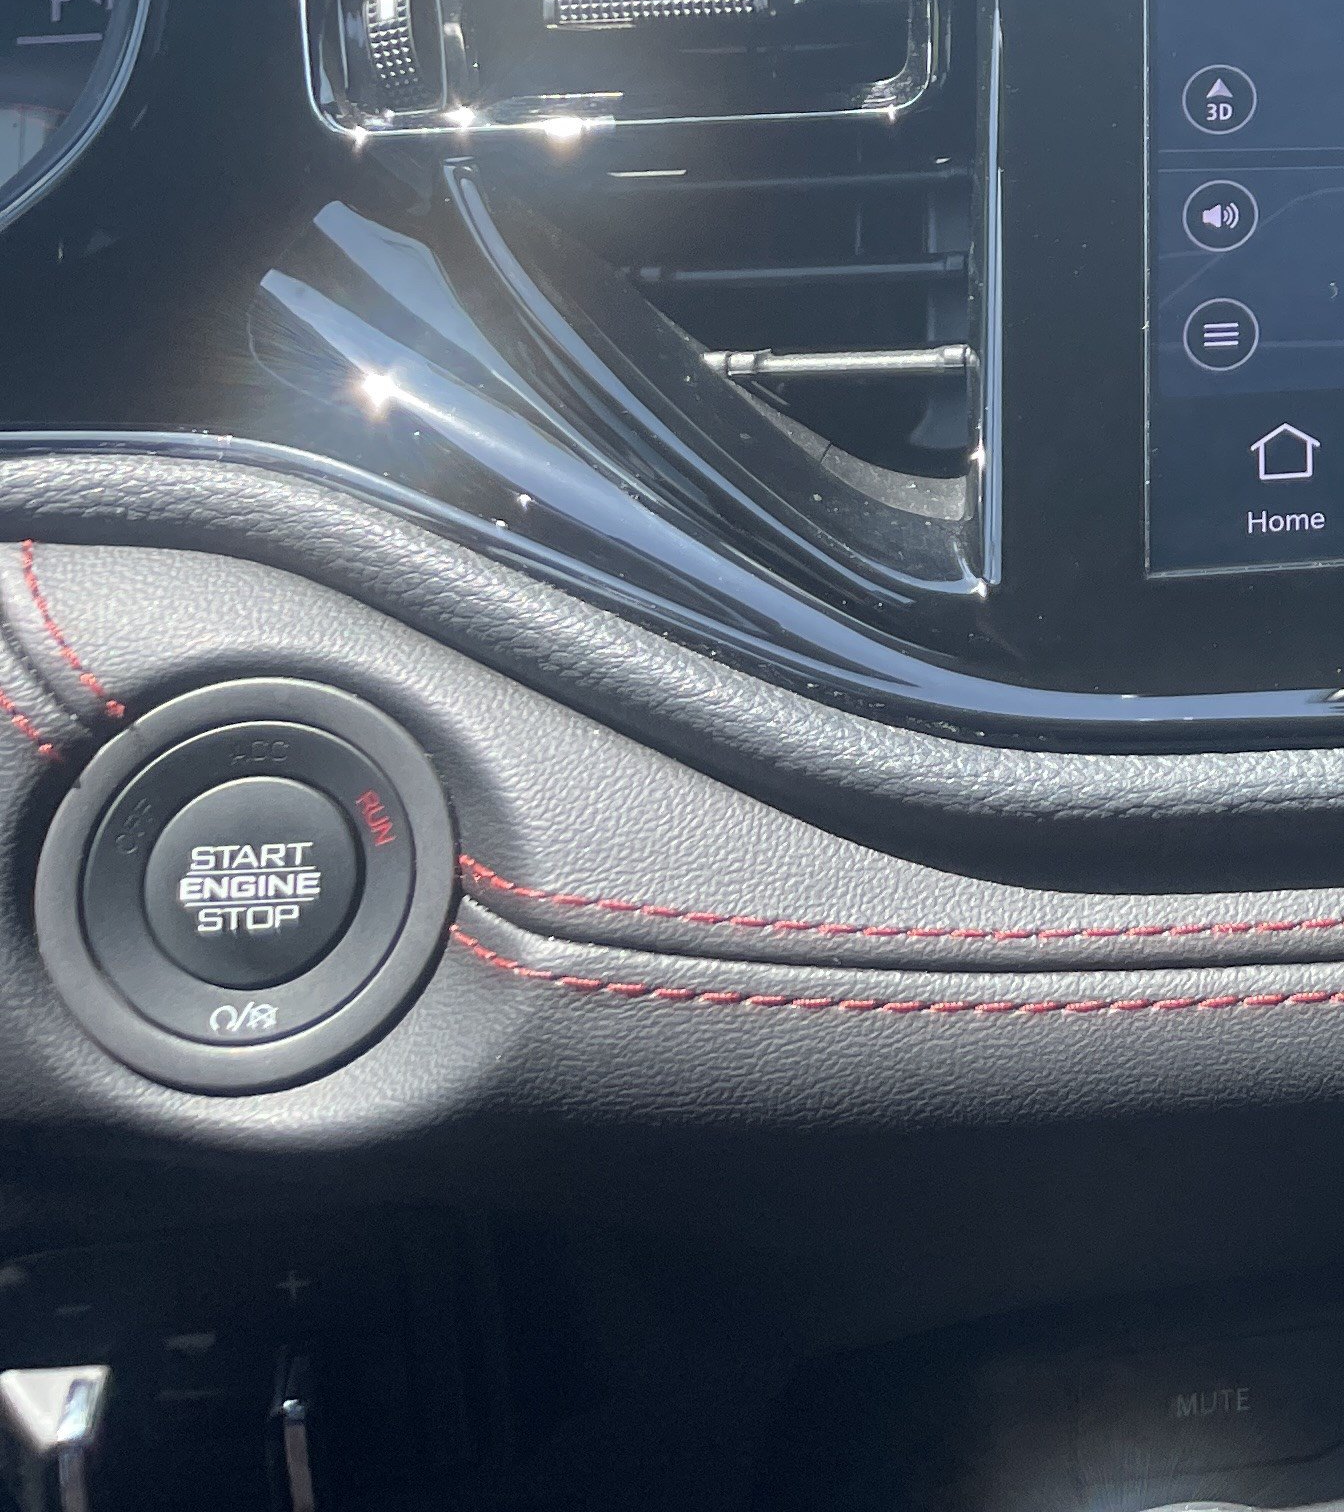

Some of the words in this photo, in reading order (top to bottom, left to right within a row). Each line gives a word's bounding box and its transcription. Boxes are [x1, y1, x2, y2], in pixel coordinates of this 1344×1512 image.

[1206, 103, 1233, 121] 3D
[1247, 509, 1326, 535] Home
[355, 789, 398, 848] RUN
[190, 841, 314, 871] START
[179, 871, 322, 901] ENGINE
[197, 904, 300, 933] STOP
[1177, 1387, 1251, 1418] MUTE
